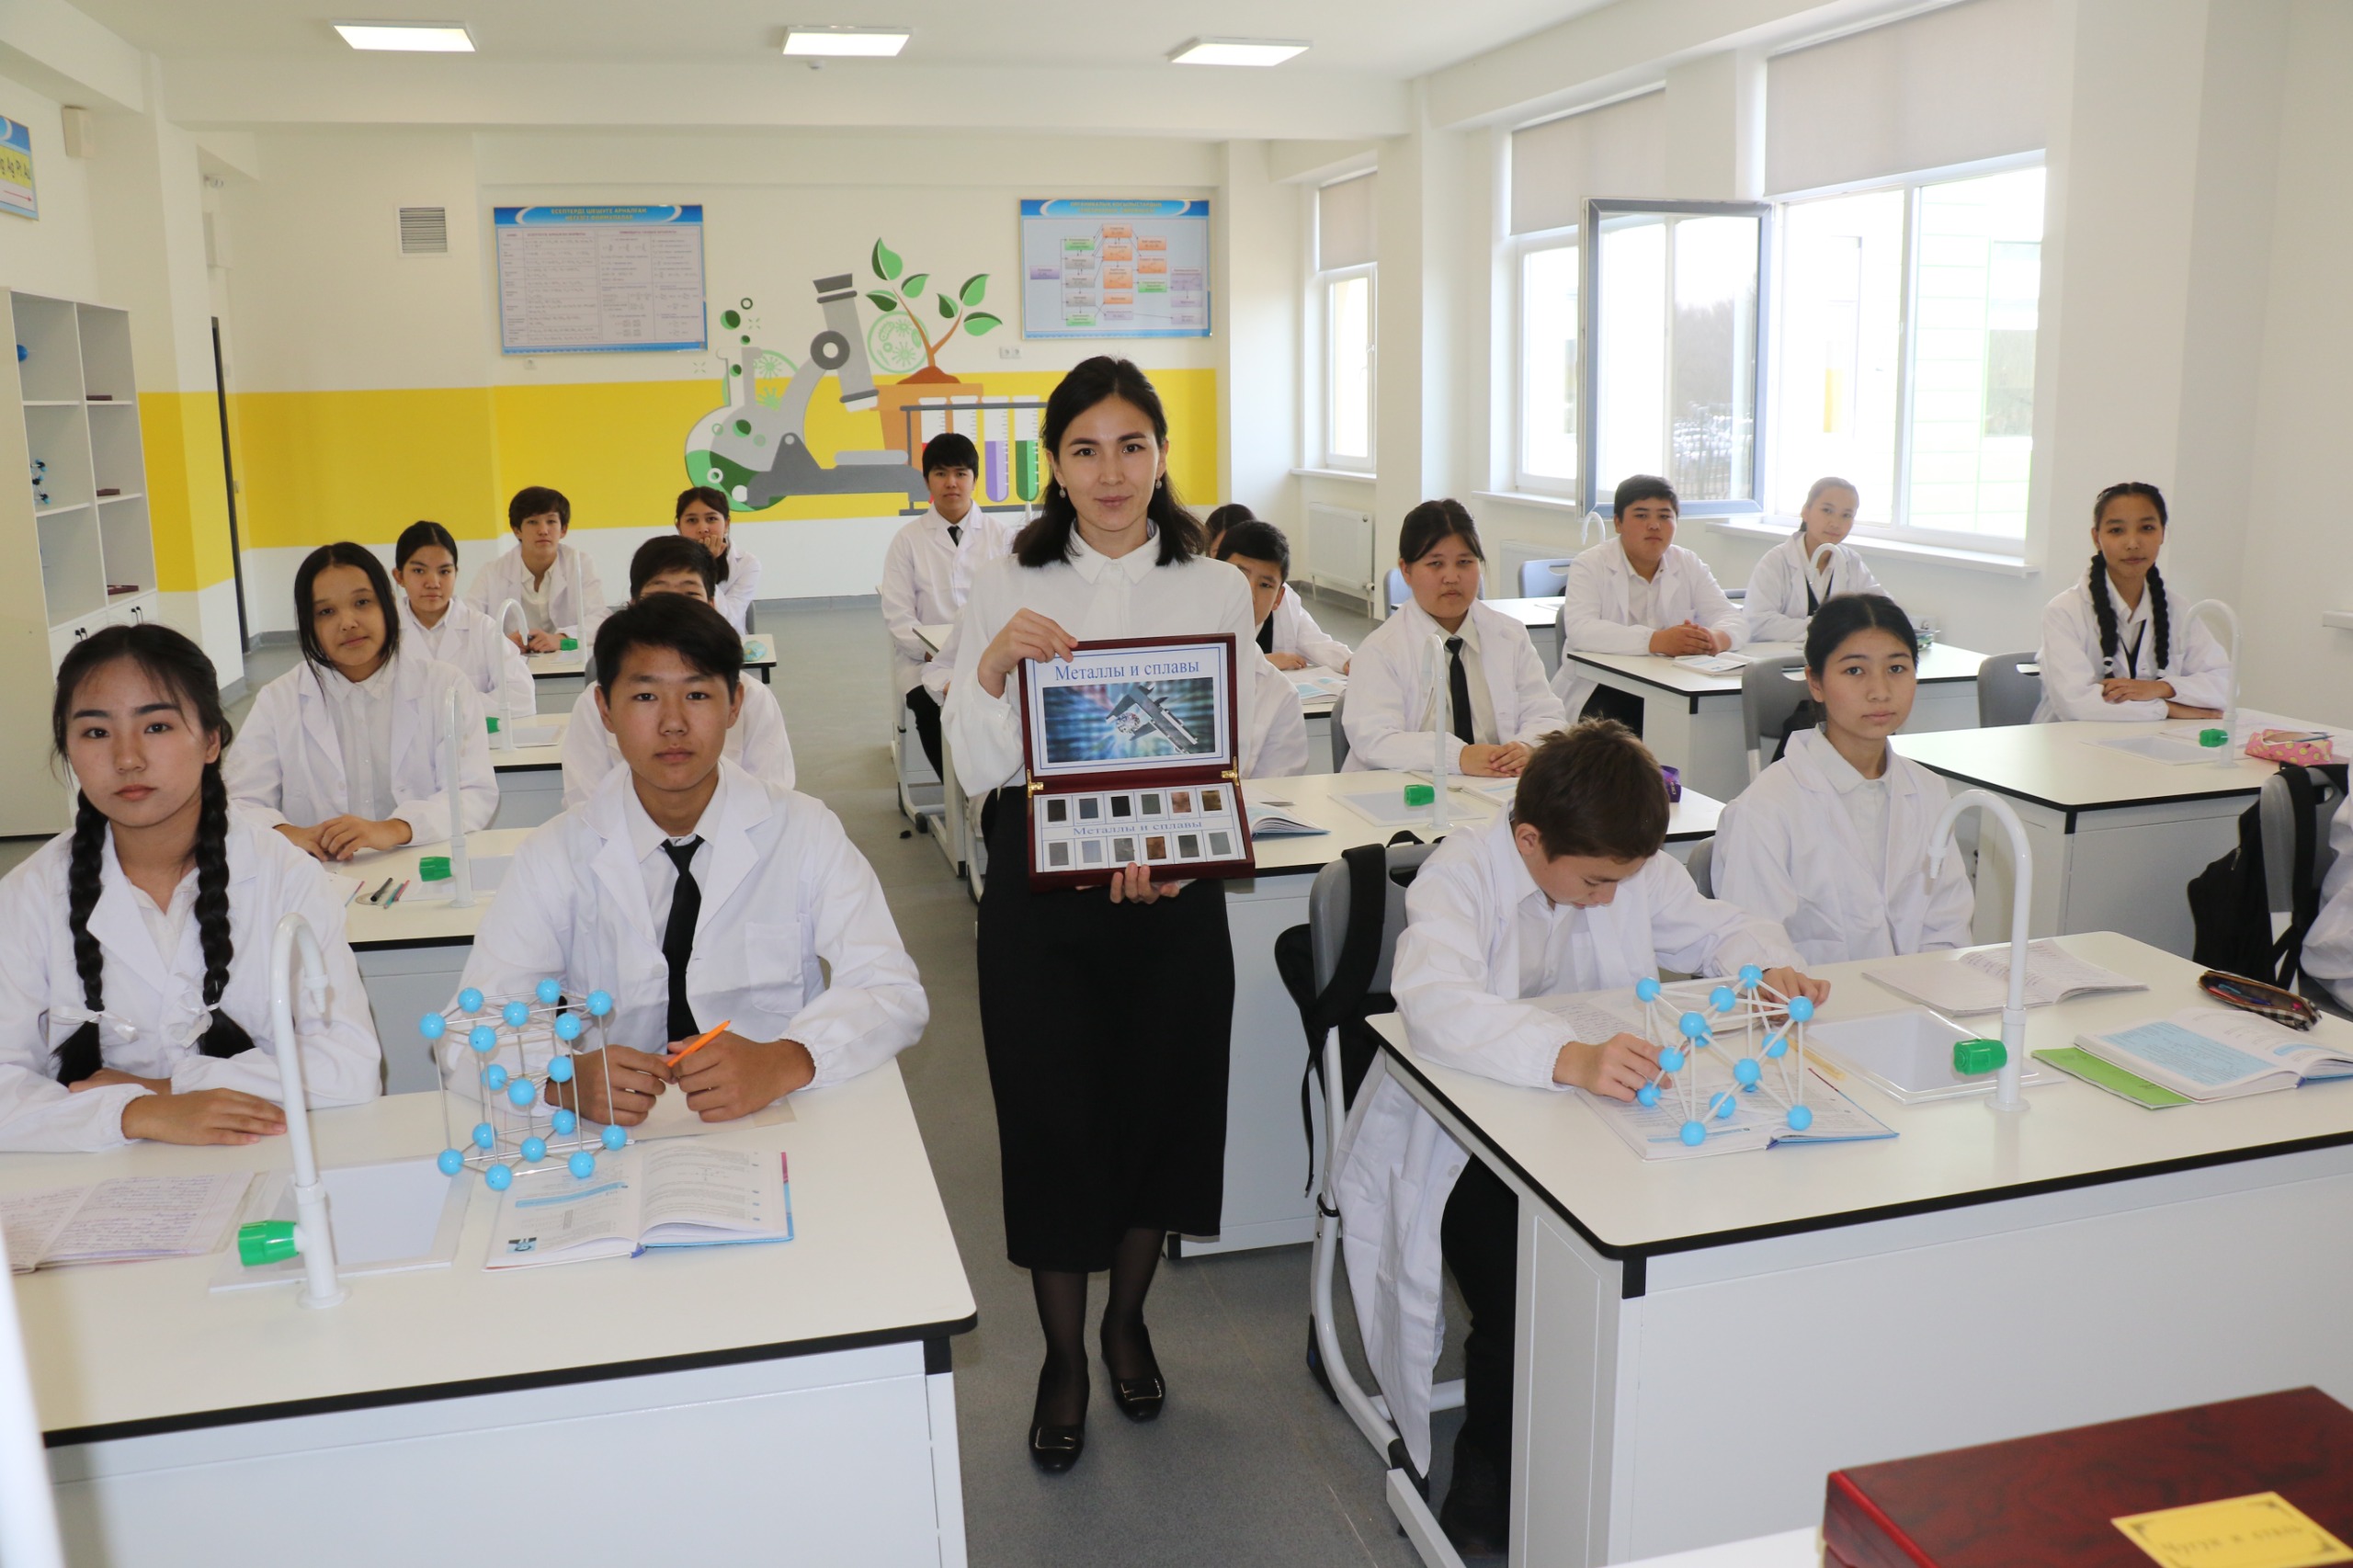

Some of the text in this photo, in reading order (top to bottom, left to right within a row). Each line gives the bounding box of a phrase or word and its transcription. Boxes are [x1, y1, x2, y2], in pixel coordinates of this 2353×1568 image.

[1055, 661, 1199, 680] Металлы и сплавы
[1073, 825, 1135, 835] Металлы
[1153, 821, 1202, 831] сплавы
